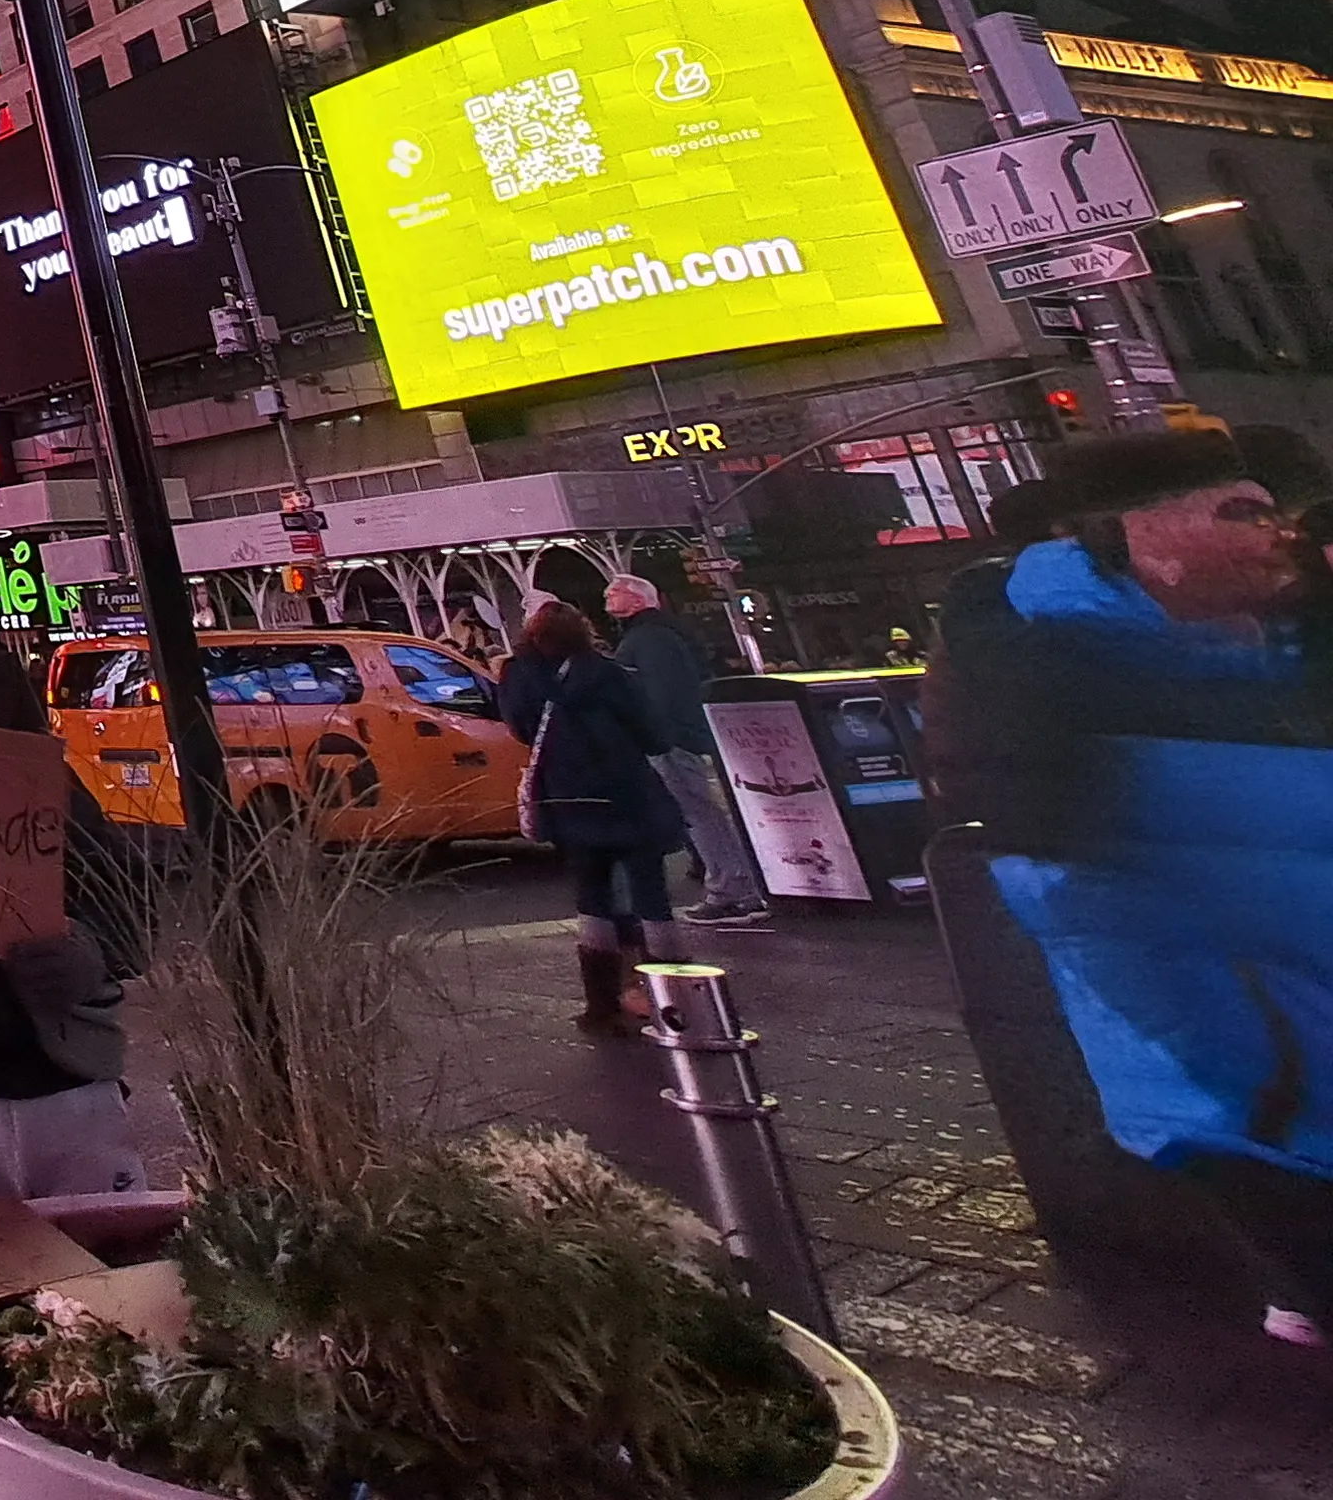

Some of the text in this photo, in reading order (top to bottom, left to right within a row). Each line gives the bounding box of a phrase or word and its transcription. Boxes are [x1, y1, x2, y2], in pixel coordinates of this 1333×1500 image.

[1079, 37, 1171, 77] MILLER
[649, 124, 763, 160] Ingredients
[675, 117, 722, 137] Zero
[99, 158, 194, 213] ou for
[1011, 213, 1055, 239] ONLY
[1078, 198, 1133, 225] ONLY
[106, 213, 172, 257] eaut
[529, 222, 634, 262] Available at:
[953, 225, 998, 250] ONLY
[1011, 248, 1117, 285] ONE WAY
[442, 234, 804, 342] superpatch.com
